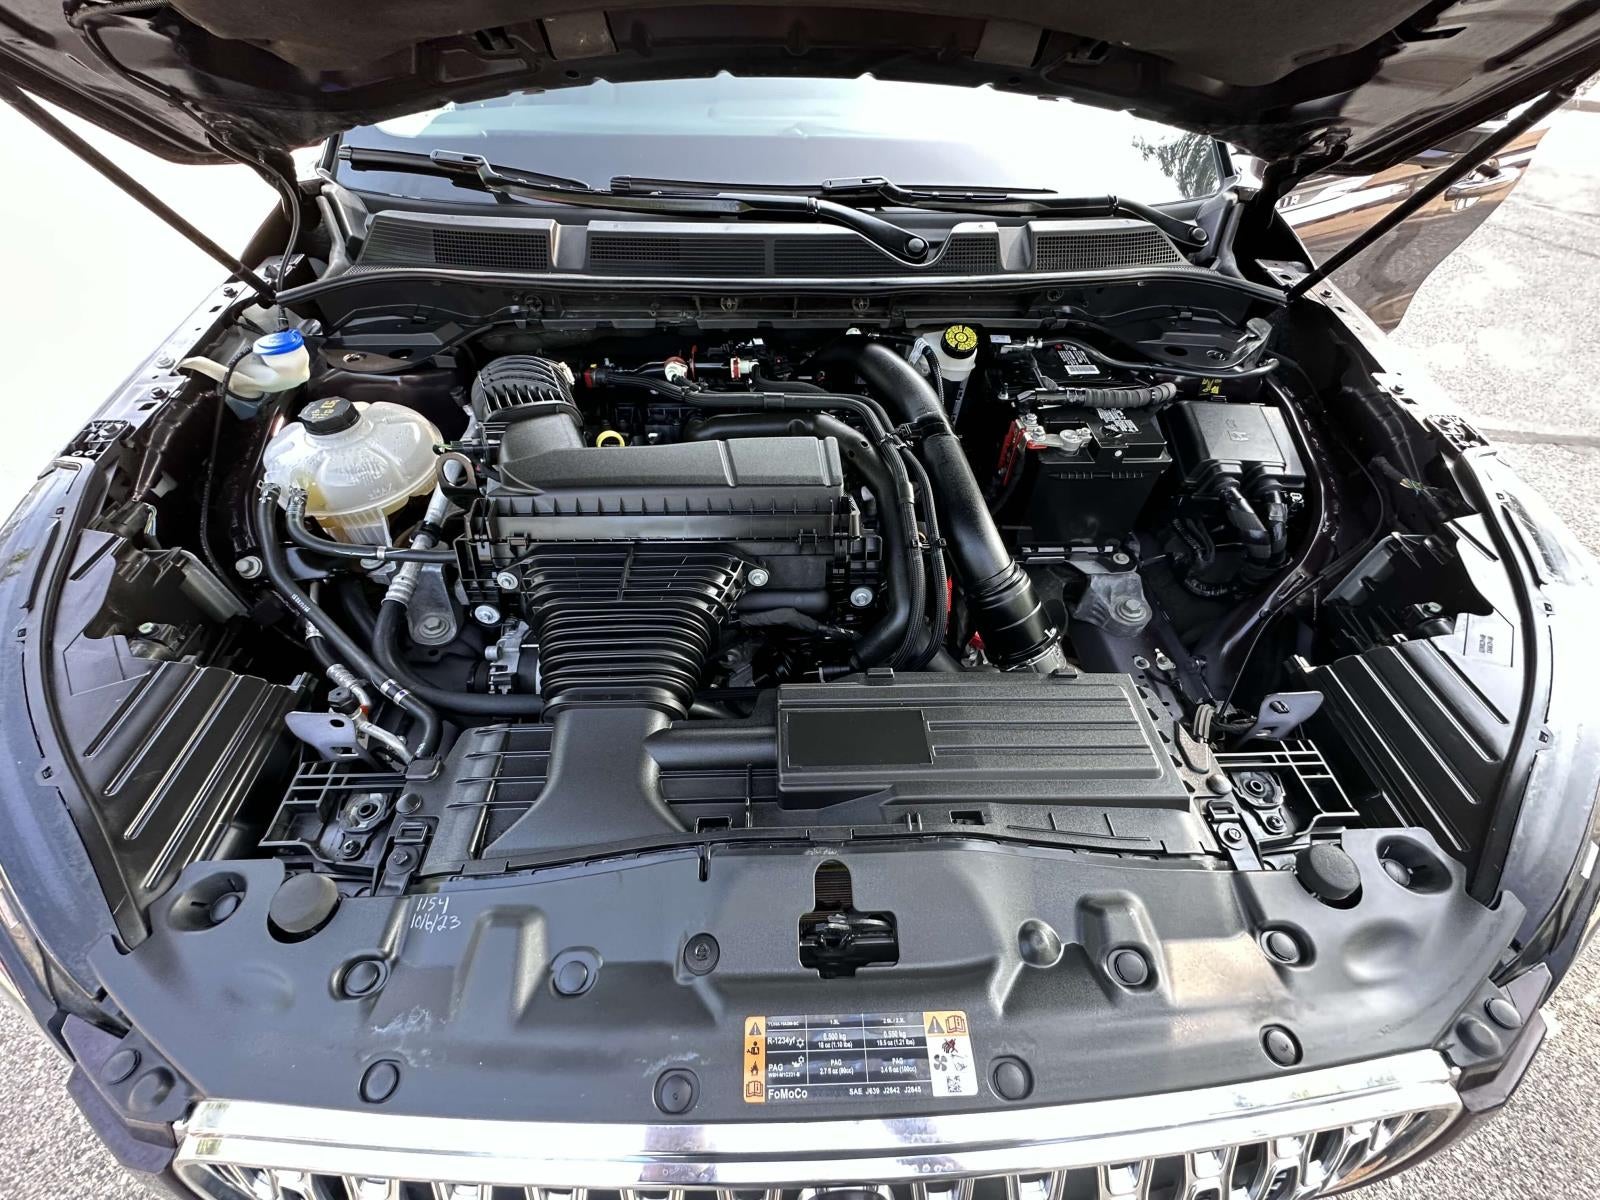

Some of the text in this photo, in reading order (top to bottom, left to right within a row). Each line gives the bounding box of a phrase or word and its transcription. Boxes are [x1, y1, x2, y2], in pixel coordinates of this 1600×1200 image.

[416, 895, 450, 914] 1154
[409, 913, 461, 933] 10/6/23
[767, 1037, 796, 1046] R-1234yf
[892, 1057, 903, 1065] PAG
[768, 1063, 784, 1072] PAG
[768, 1088, 808, 1099] FoMoCo
